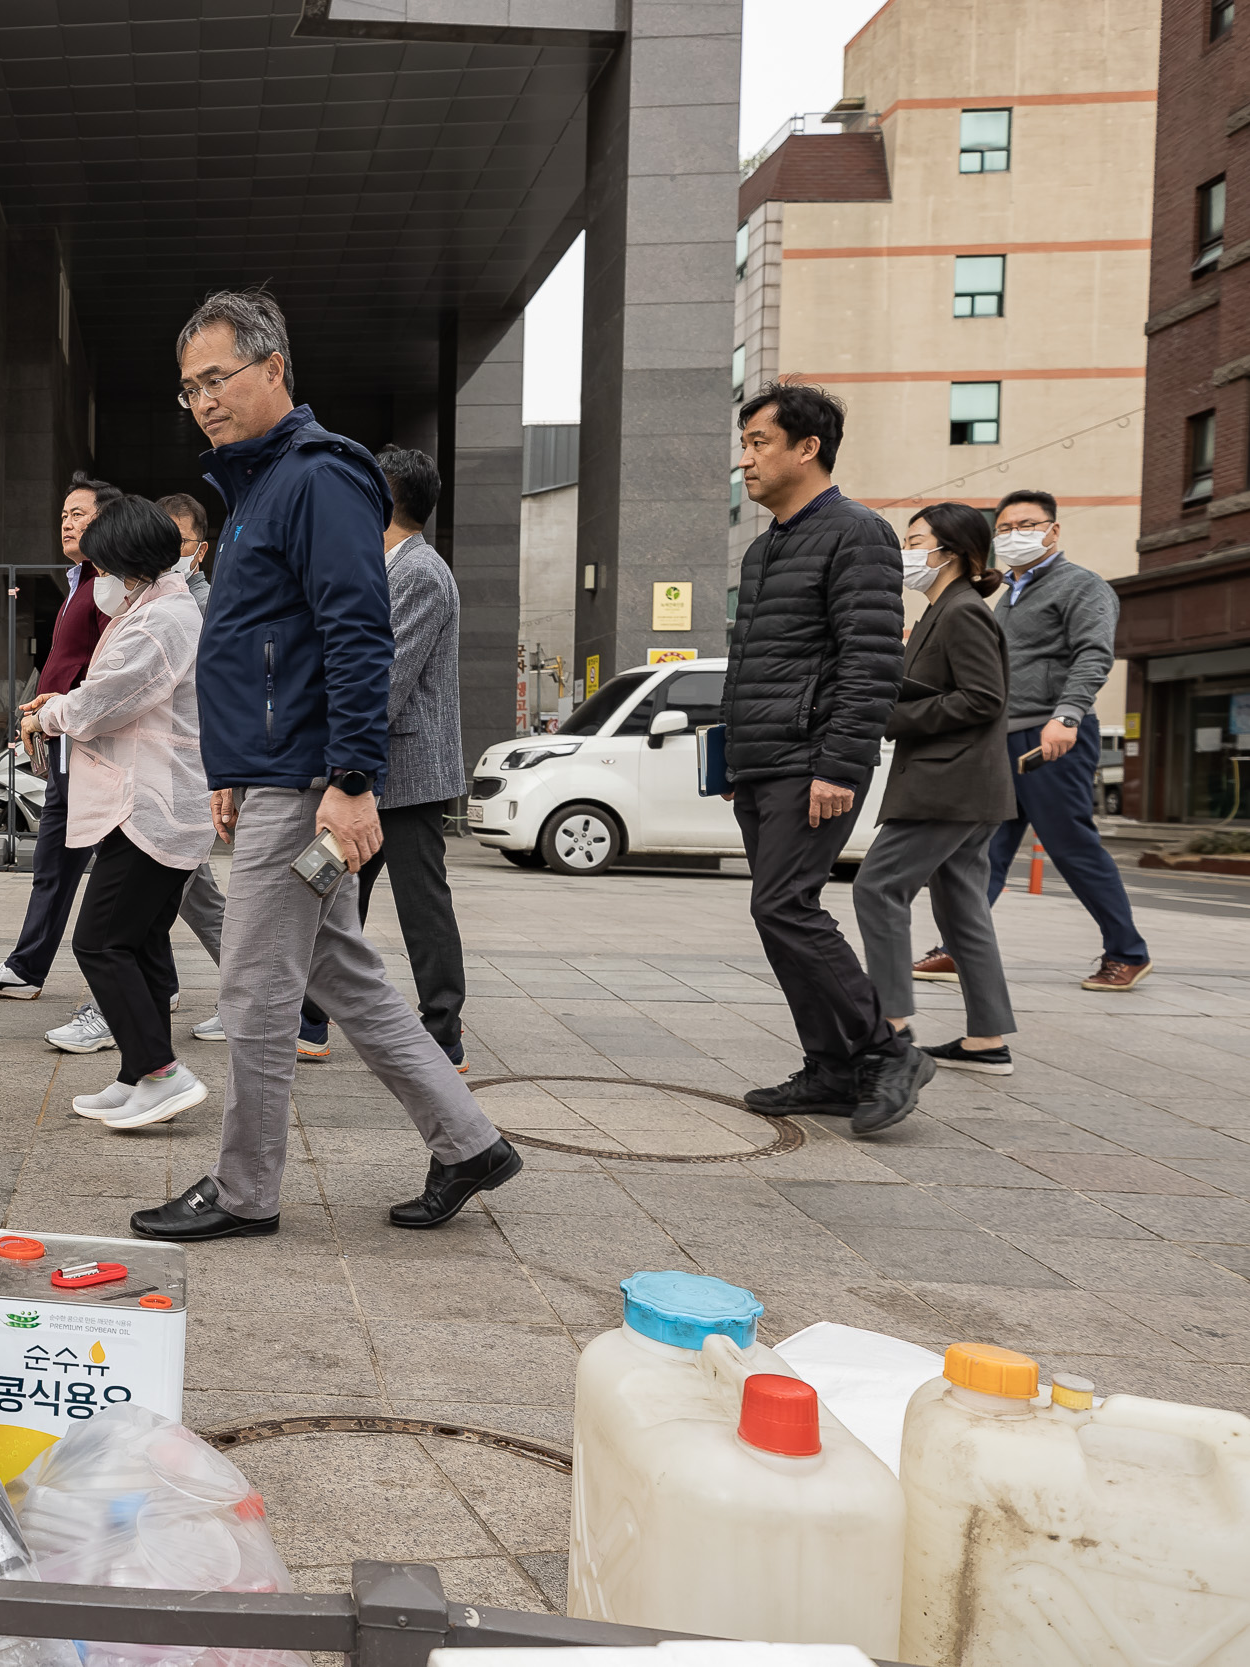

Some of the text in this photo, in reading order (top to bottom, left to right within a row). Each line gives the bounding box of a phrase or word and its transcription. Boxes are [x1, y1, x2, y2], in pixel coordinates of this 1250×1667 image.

[50, 1323, 130, 1336] PREMIUM SOYBEAN OIL
